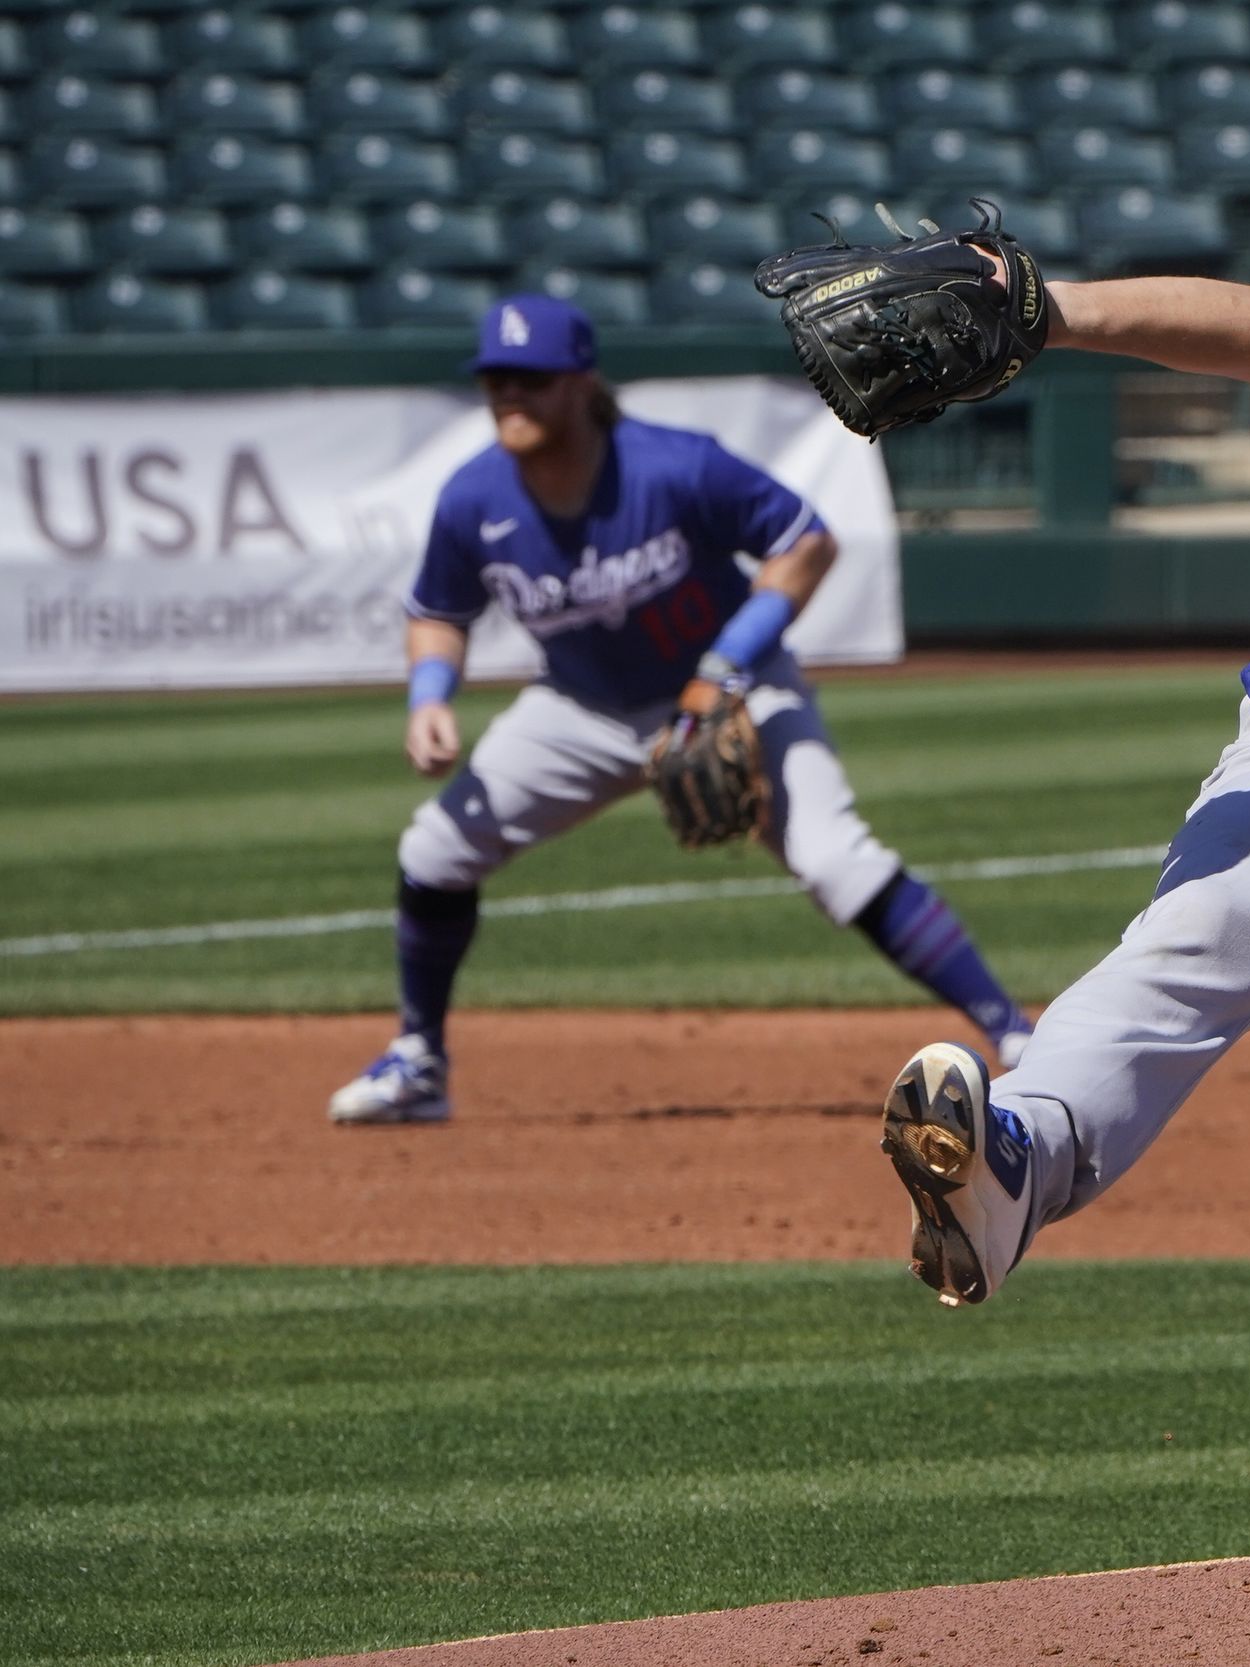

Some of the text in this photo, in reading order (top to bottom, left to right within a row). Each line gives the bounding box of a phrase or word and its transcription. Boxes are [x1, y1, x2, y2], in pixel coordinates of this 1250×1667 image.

[815, 266, 880, 303] A2000
[1016, 252, 1037, 320] Wilson
[22, 448, 307, 558] USA
[480, 530, 691, 634] Dodgers
[640, 580, 716, 662] 10
